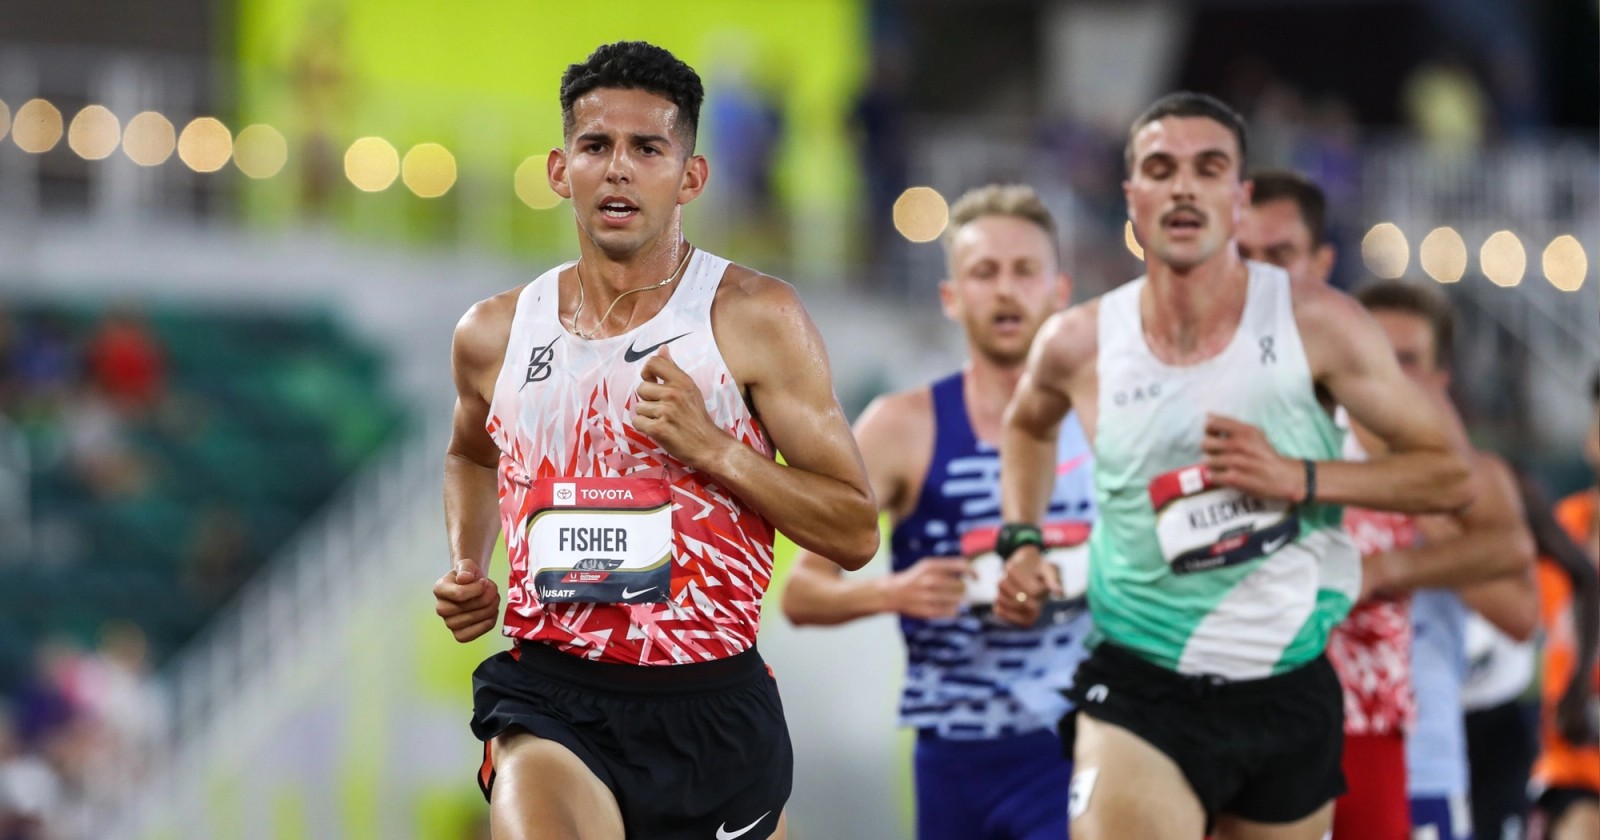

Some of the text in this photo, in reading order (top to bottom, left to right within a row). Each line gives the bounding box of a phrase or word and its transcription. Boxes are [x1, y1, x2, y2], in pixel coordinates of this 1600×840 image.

[580, 489, 634, 500] TOYOTA
[559, 527, 627, 552] FISHER
[545, 589, 576, 598] USATF
